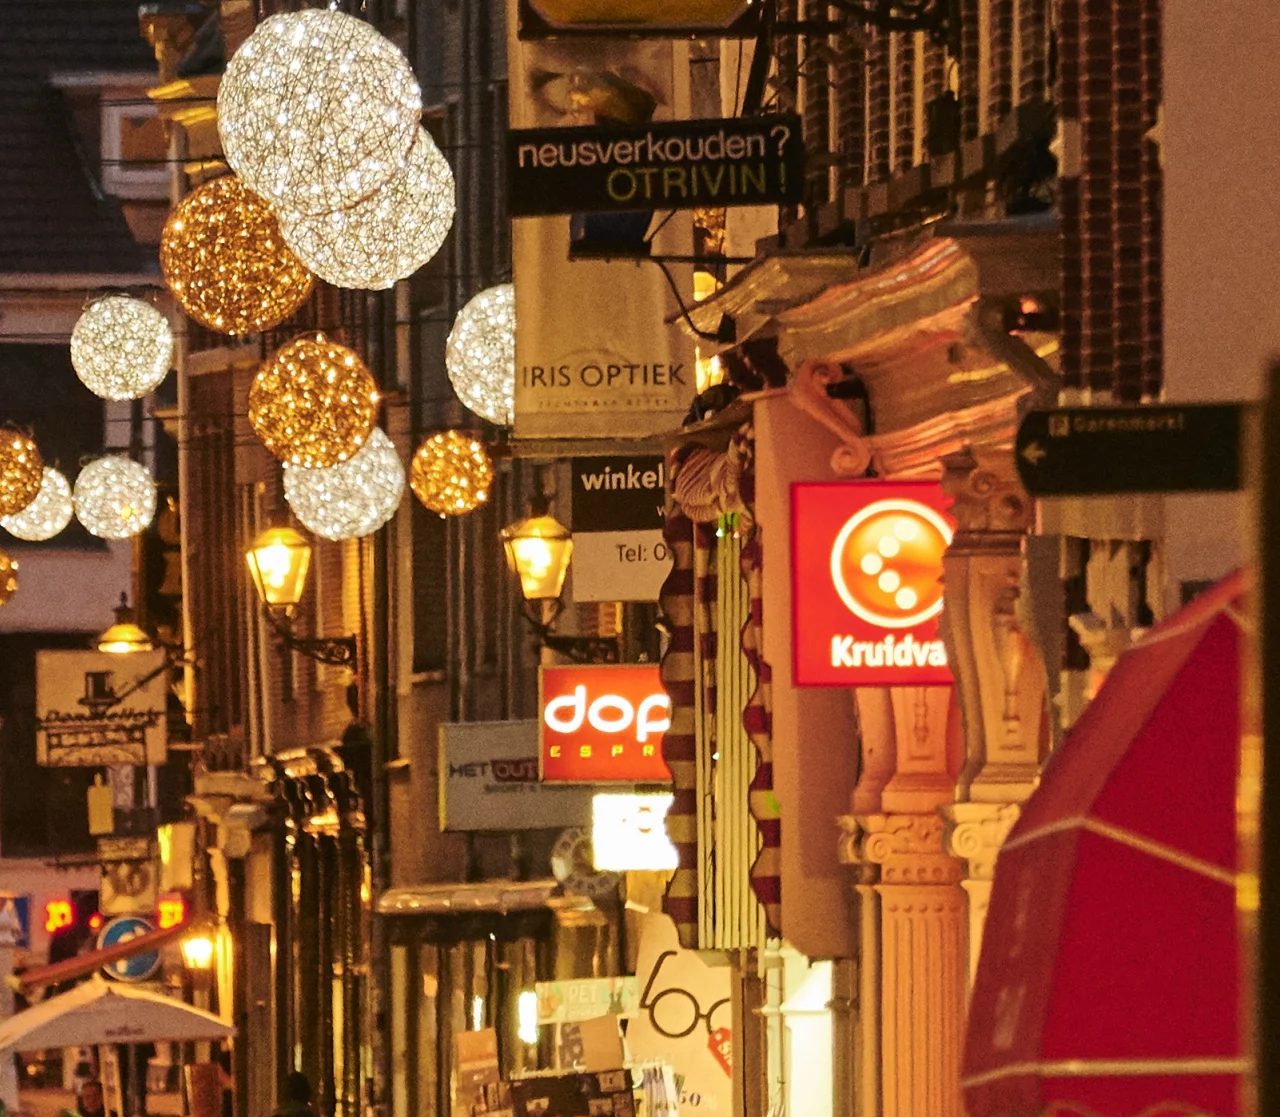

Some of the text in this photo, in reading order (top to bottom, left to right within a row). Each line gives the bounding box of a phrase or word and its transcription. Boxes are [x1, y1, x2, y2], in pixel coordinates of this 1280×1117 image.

[522, 363, 687, 388] IRIS OPTIEK
[580, 462, 664, 492] winkel
